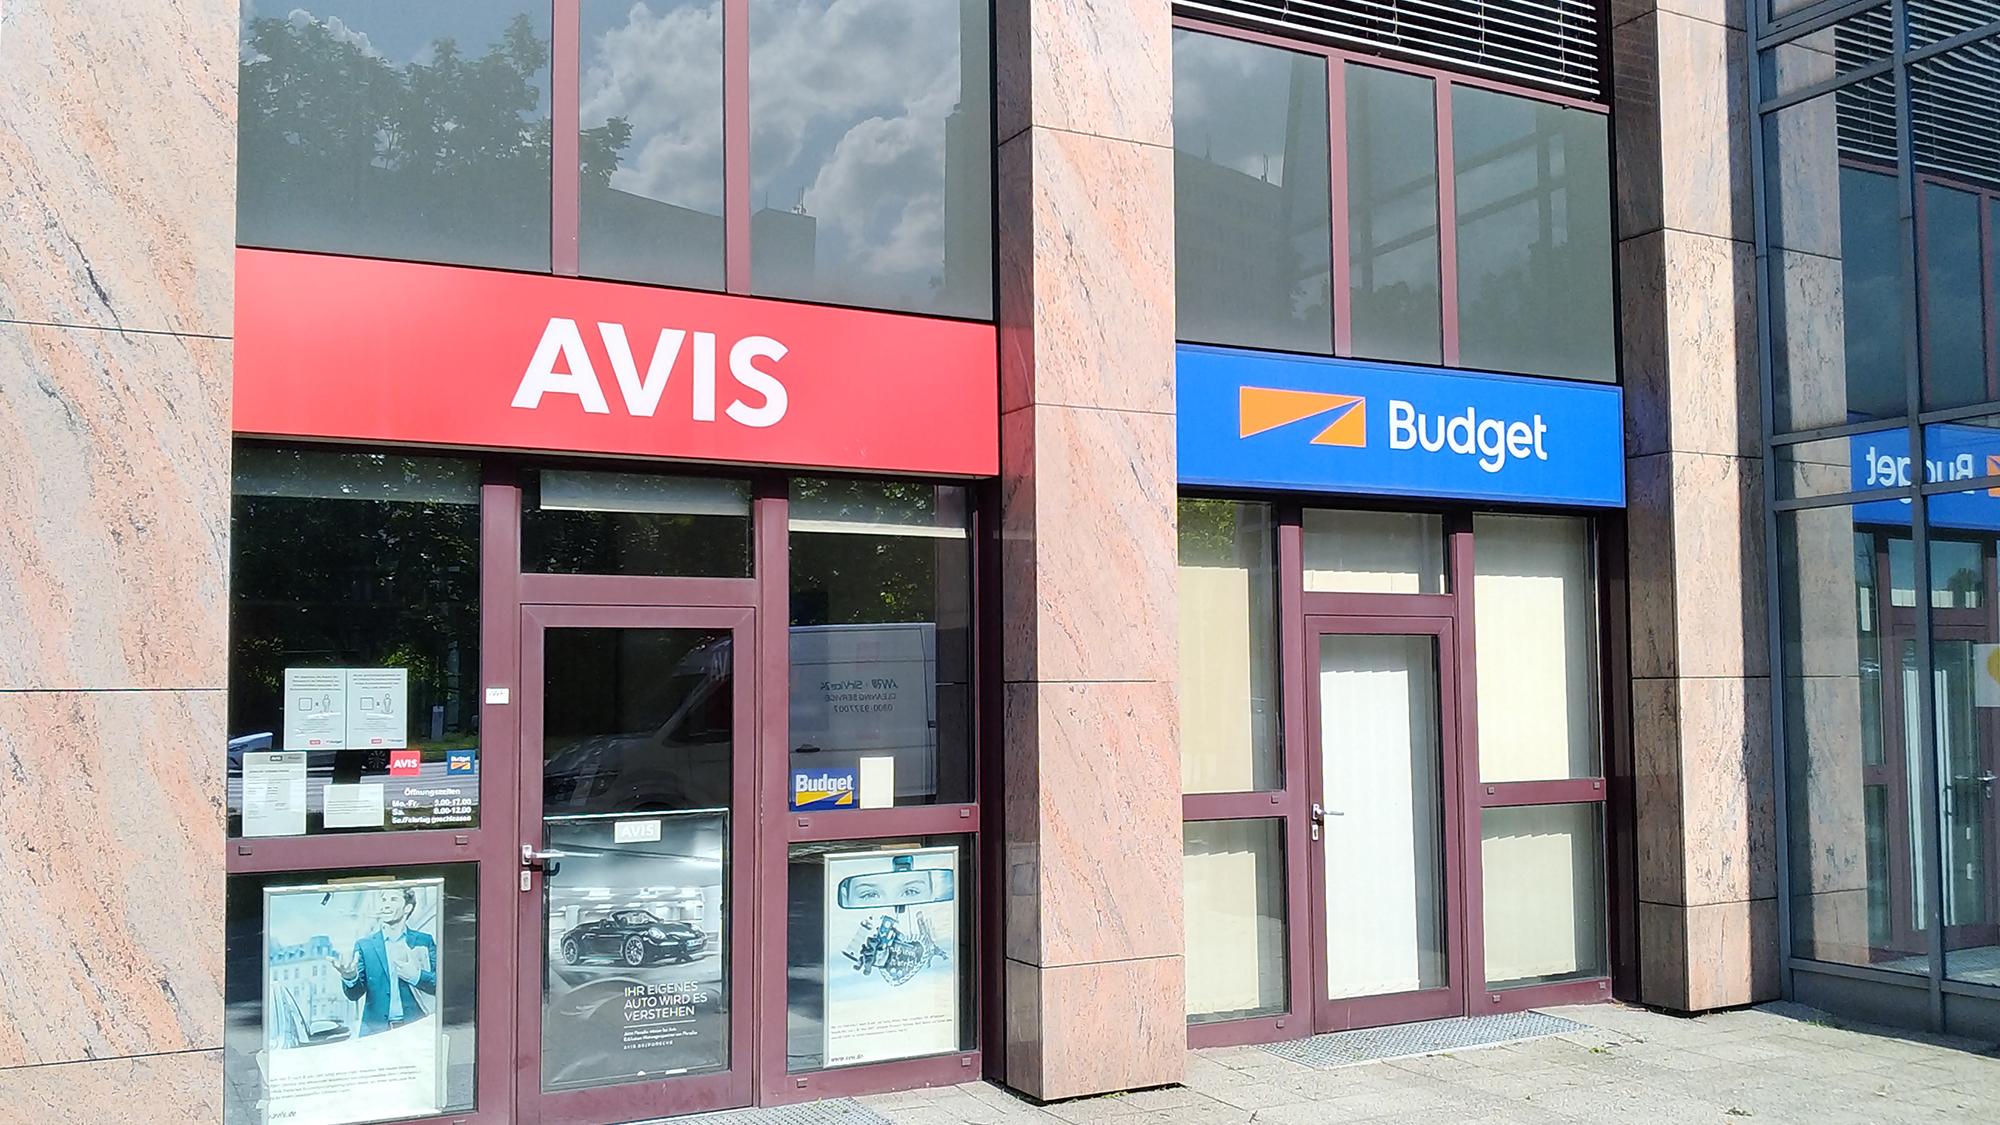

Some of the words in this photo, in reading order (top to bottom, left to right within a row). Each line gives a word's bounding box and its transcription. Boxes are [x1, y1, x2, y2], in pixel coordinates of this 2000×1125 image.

[511, 317, 789, 428] AVIS
[1389, 399, 1548, 473] Budget
[393, 759, 417, 768] AVIS
[795, 773, 854, 795] Budget
[621, 822, 654, 838] AVIS
[624, 986, 645, 997] IHR
[647, 981, 698, 995] EIGENES
[624, 996, 657, 1009] AUTO
[659, 993, 691, 1006] WIRD
[693, 992, 708, 1004] ES
[624, 1005, 695, 1021] VERSTEHEN
